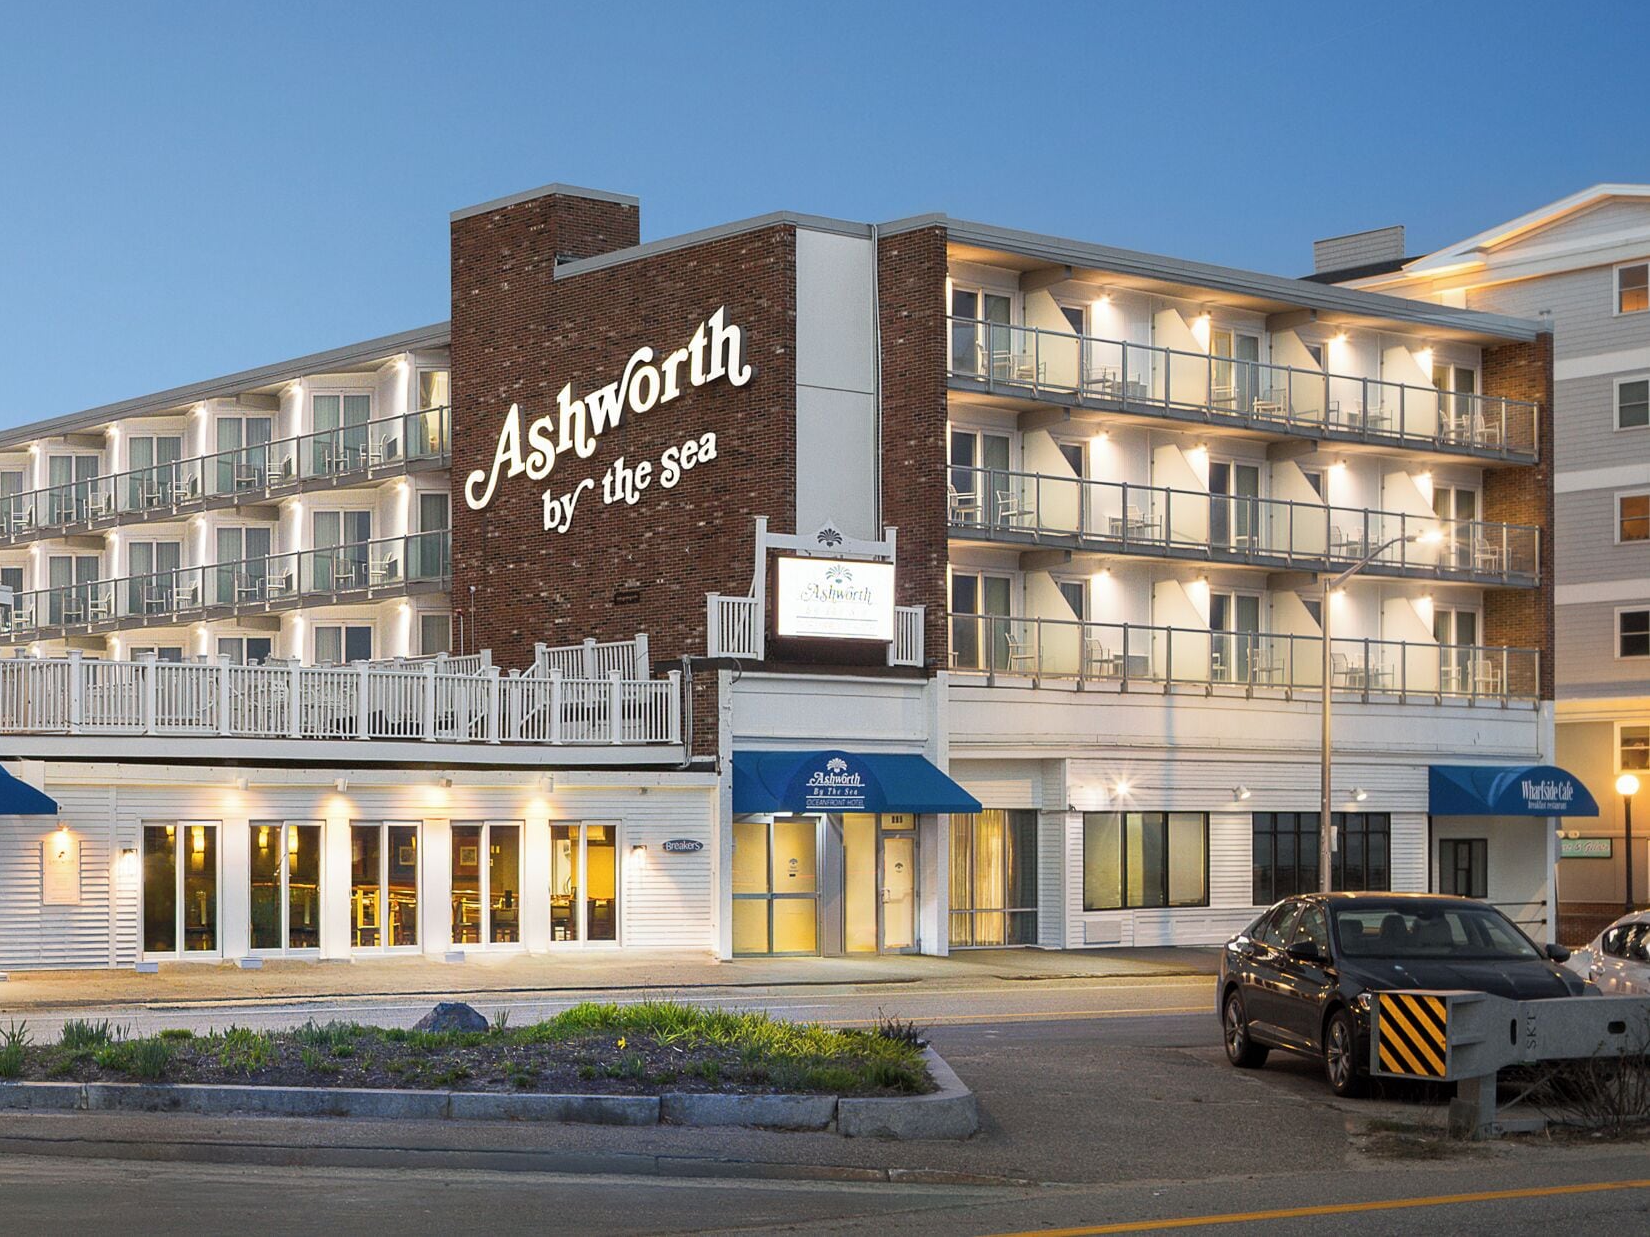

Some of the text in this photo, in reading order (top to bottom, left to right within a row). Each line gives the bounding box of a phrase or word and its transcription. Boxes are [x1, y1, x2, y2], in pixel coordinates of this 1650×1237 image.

[465, 305, 752, 510] Ashworth
[542, 478, 595, 534] by
[602, 457, 652, 505] the
[800, 582, 873, 606] Ashworth
[809, 771, 861, 787] Ashworth
[1521, 779, 1558, 801] Wharfside
[813, 787, 858, 797] By The Sea
[665, 840, 701, 851] Breakers
[1527, 1011, 1537, 1050] SKT
